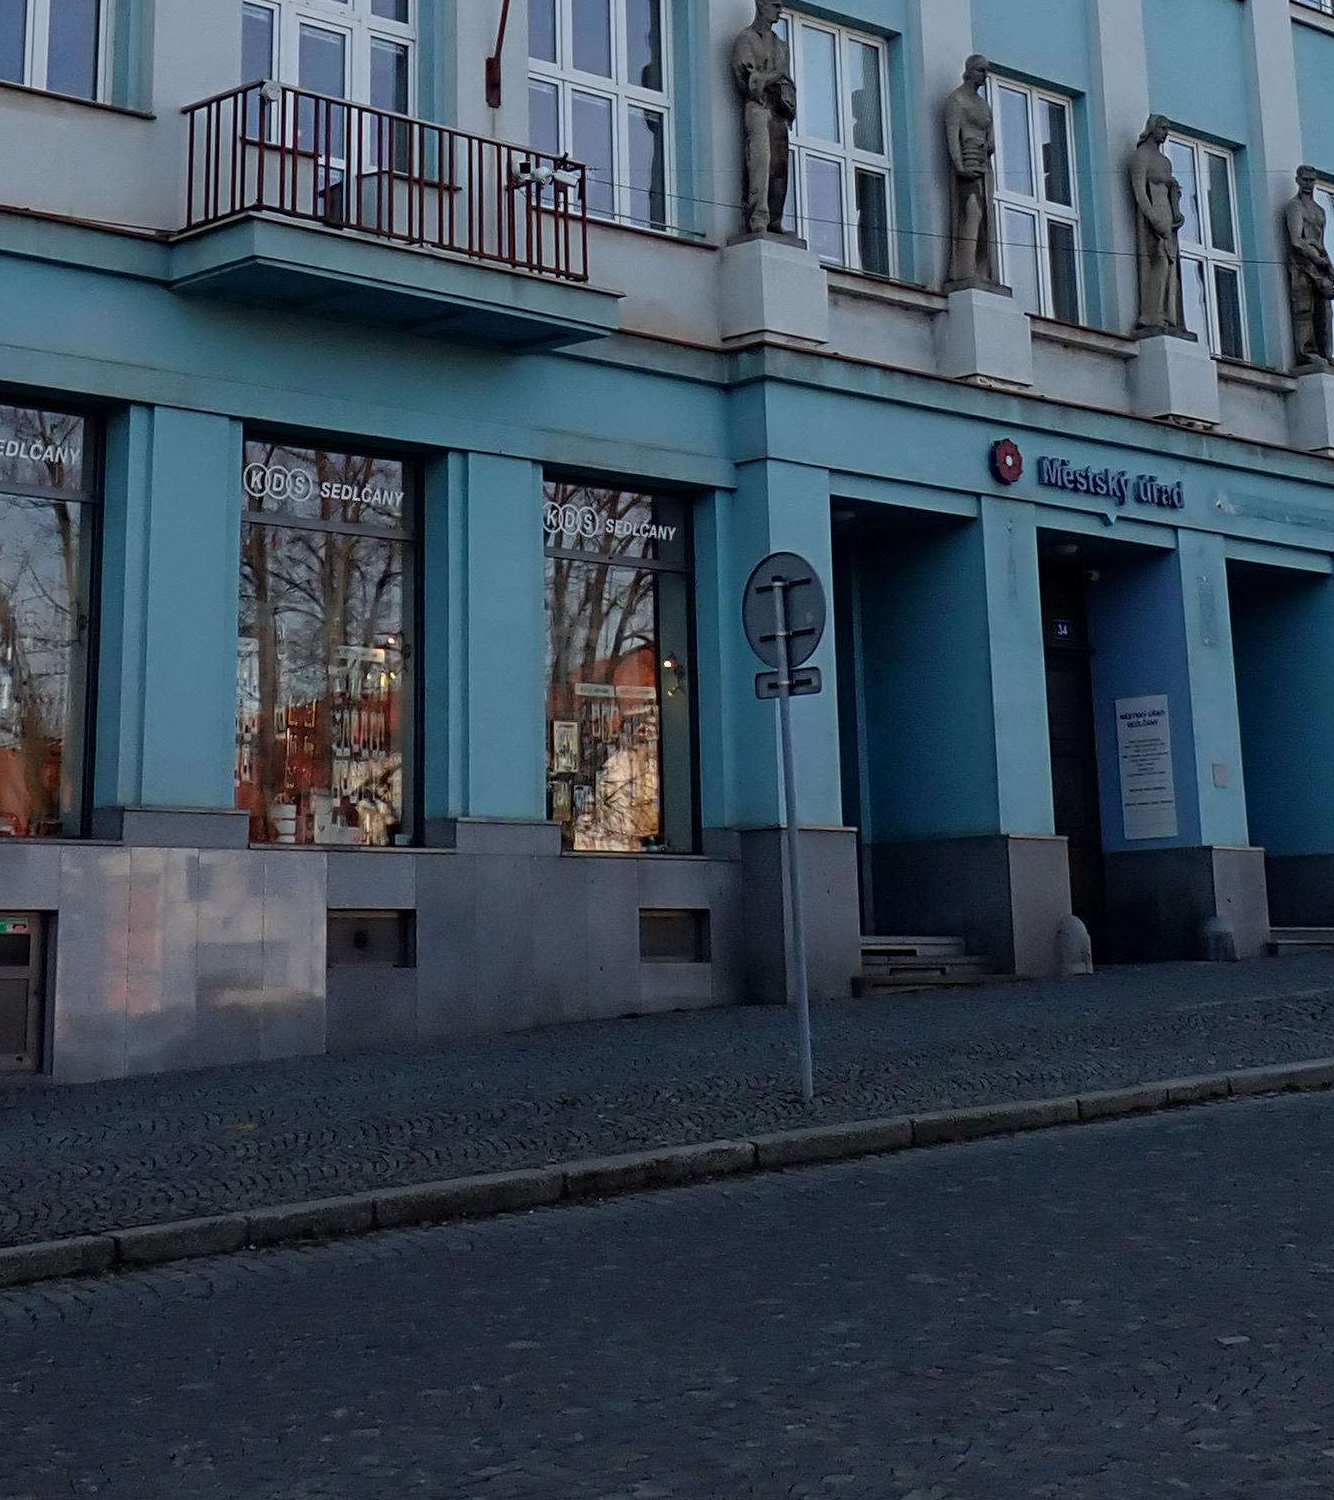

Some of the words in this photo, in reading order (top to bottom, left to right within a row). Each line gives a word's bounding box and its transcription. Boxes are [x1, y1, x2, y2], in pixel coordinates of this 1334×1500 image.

[248, 467, 308, 497] KDS
[319, 480, 404, 507] SEDLČANY
[1038, 456, 1130, 506] Městský
[545, 506, 596, 532] KDS
